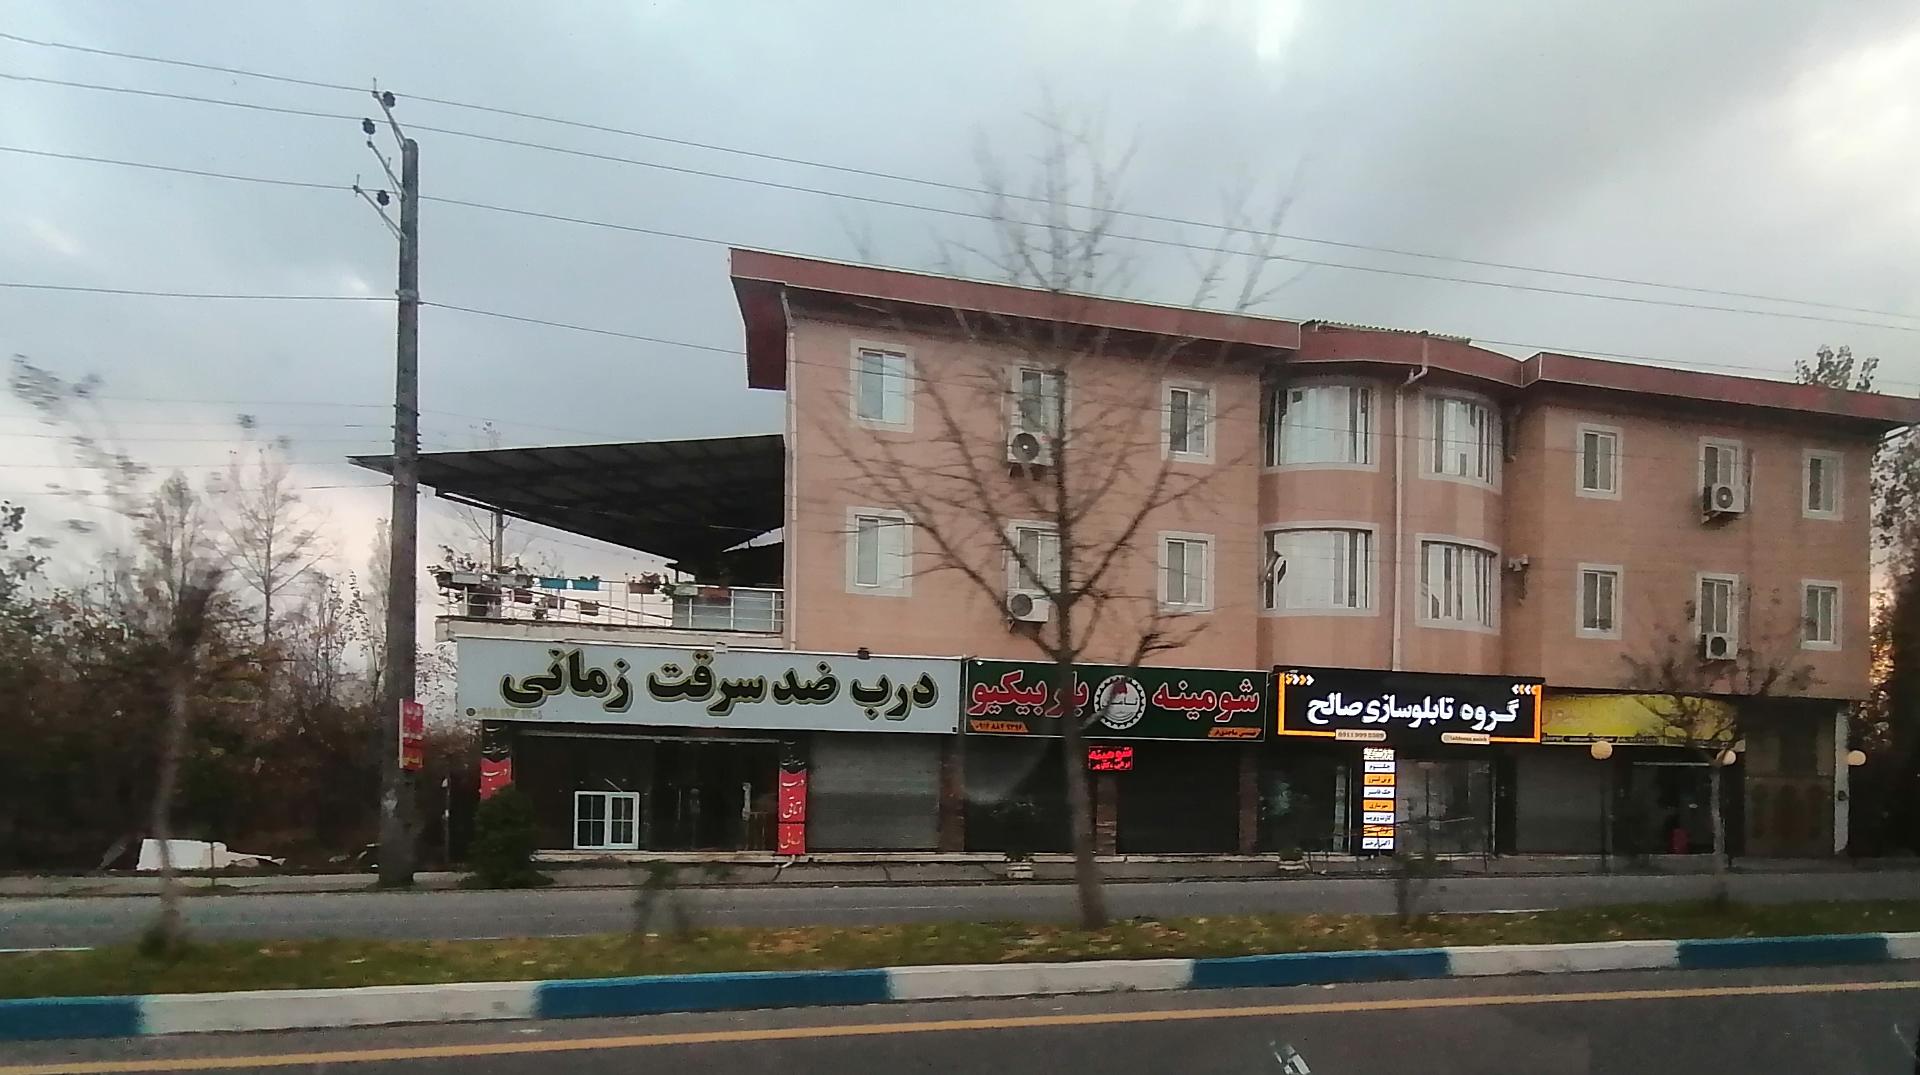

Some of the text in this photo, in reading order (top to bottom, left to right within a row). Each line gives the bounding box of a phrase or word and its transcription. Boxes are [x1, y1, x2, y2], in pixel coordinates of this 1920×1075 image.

[502, 647, 938, 720] درب ضد سرقت زمانی
[1152, 678, 1260, 722] شومینه
[1307, 692, 1520, 731] گروه تابلوسازی صالح
[1089, 747, 1132, 761] شومینه
